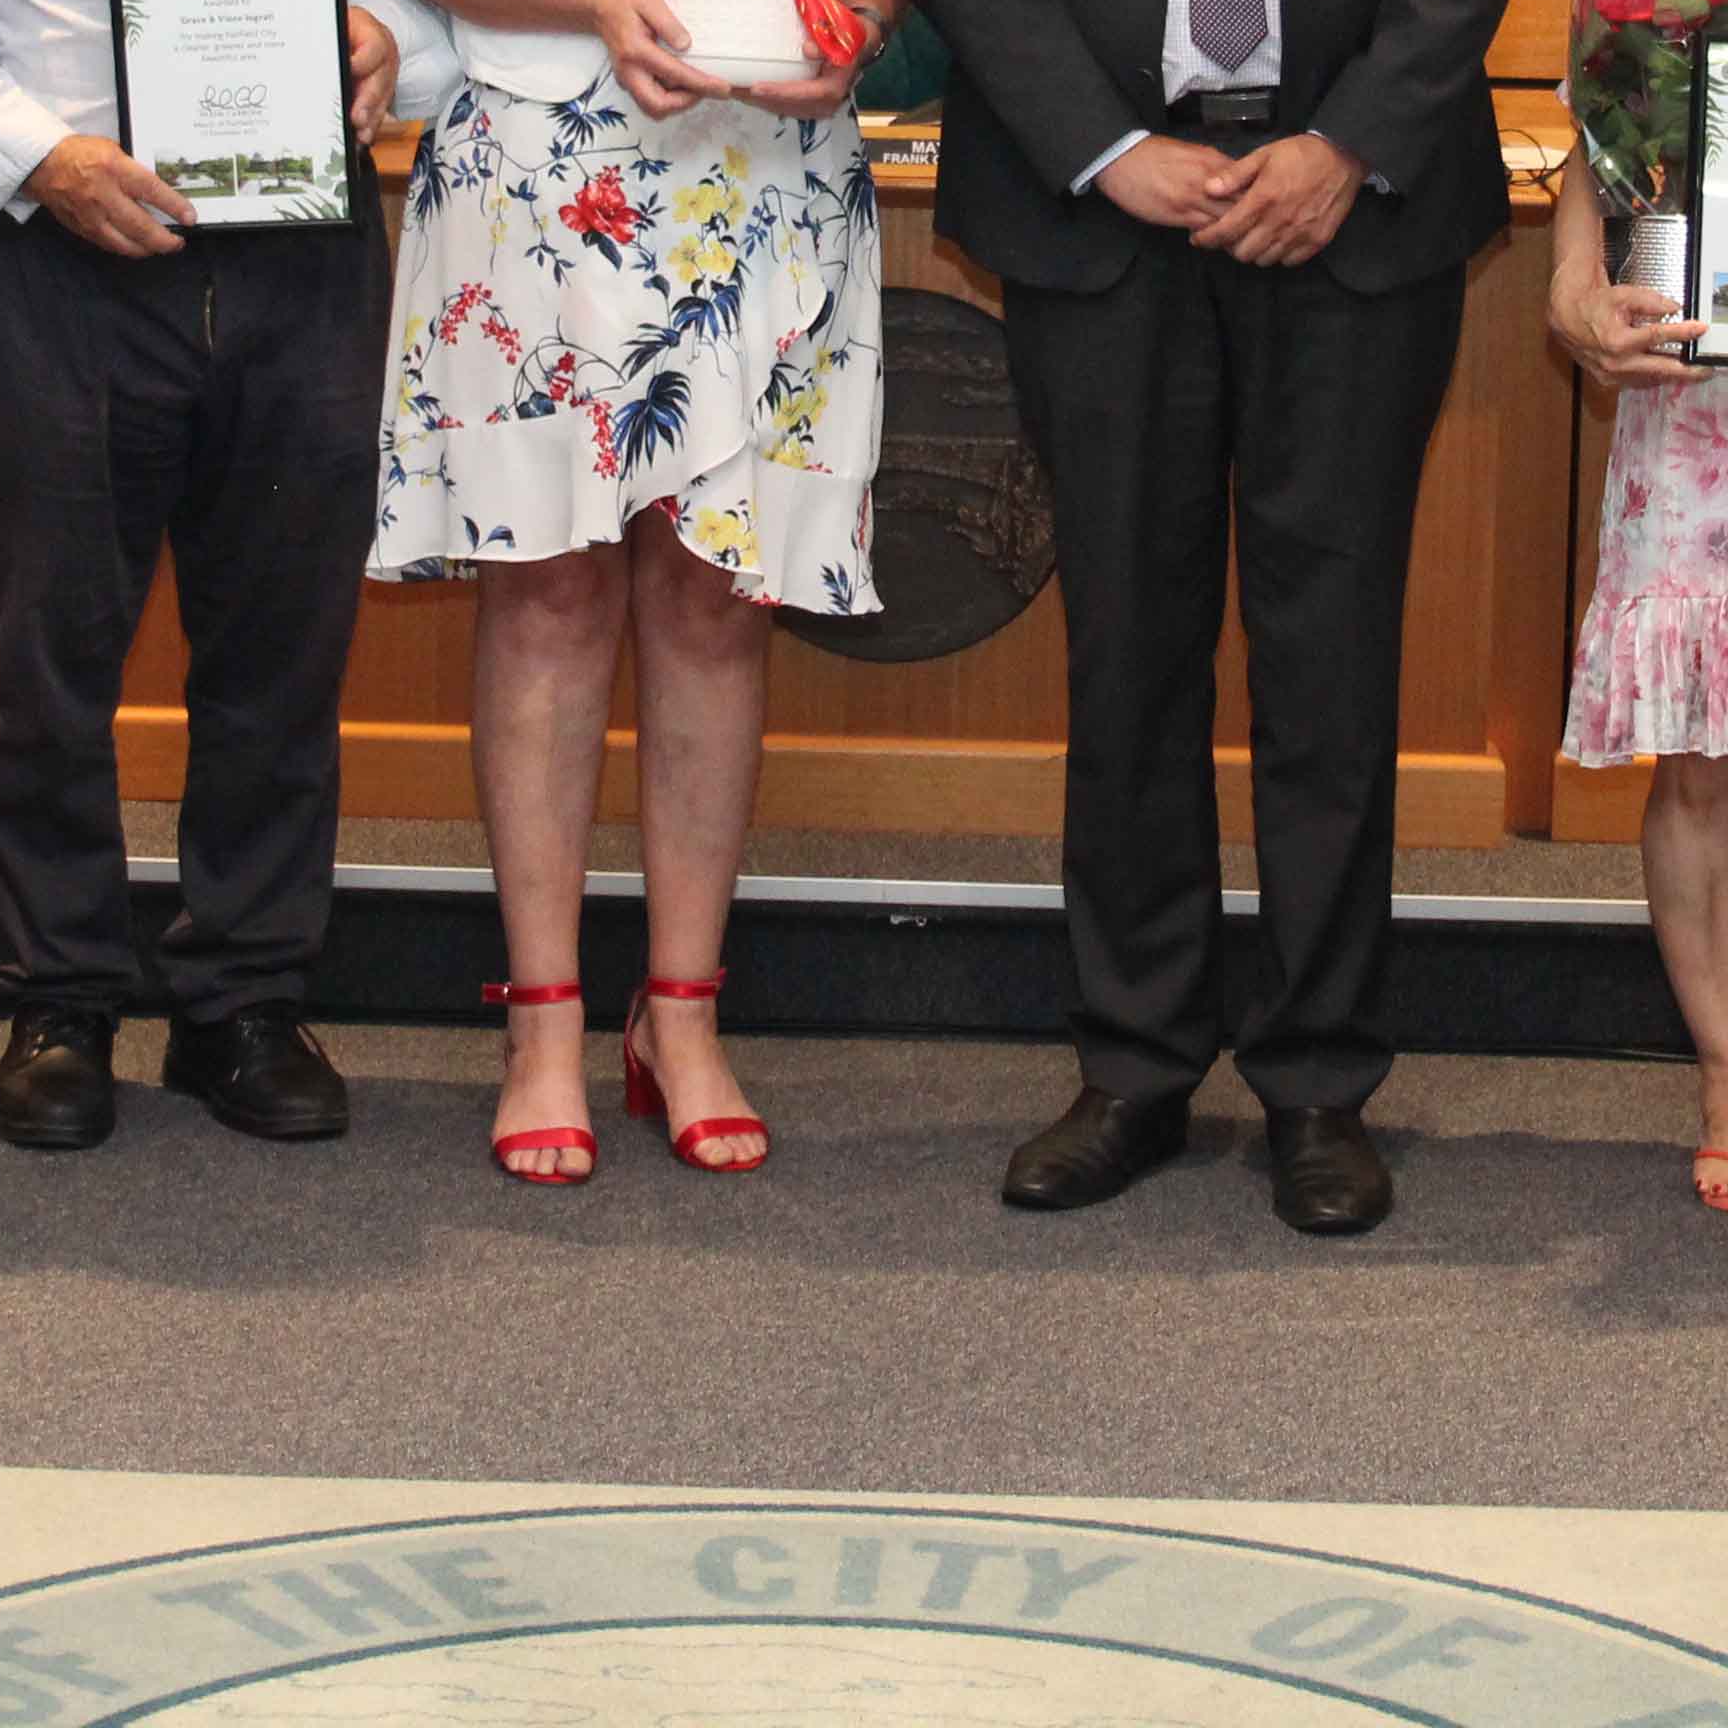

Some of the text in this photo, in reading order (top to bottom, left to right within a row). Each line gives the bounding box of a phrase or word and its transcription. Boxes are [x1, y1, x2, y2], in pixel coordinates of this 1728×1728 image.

[912, 141, 941, 153] MA
[883, 153, 929, 164] FRANK
[153, 1546, 550, 1652] THE
[691, 1534, 1141, 1620] CITY
[1246, 1594, 1534, 1683] OF
